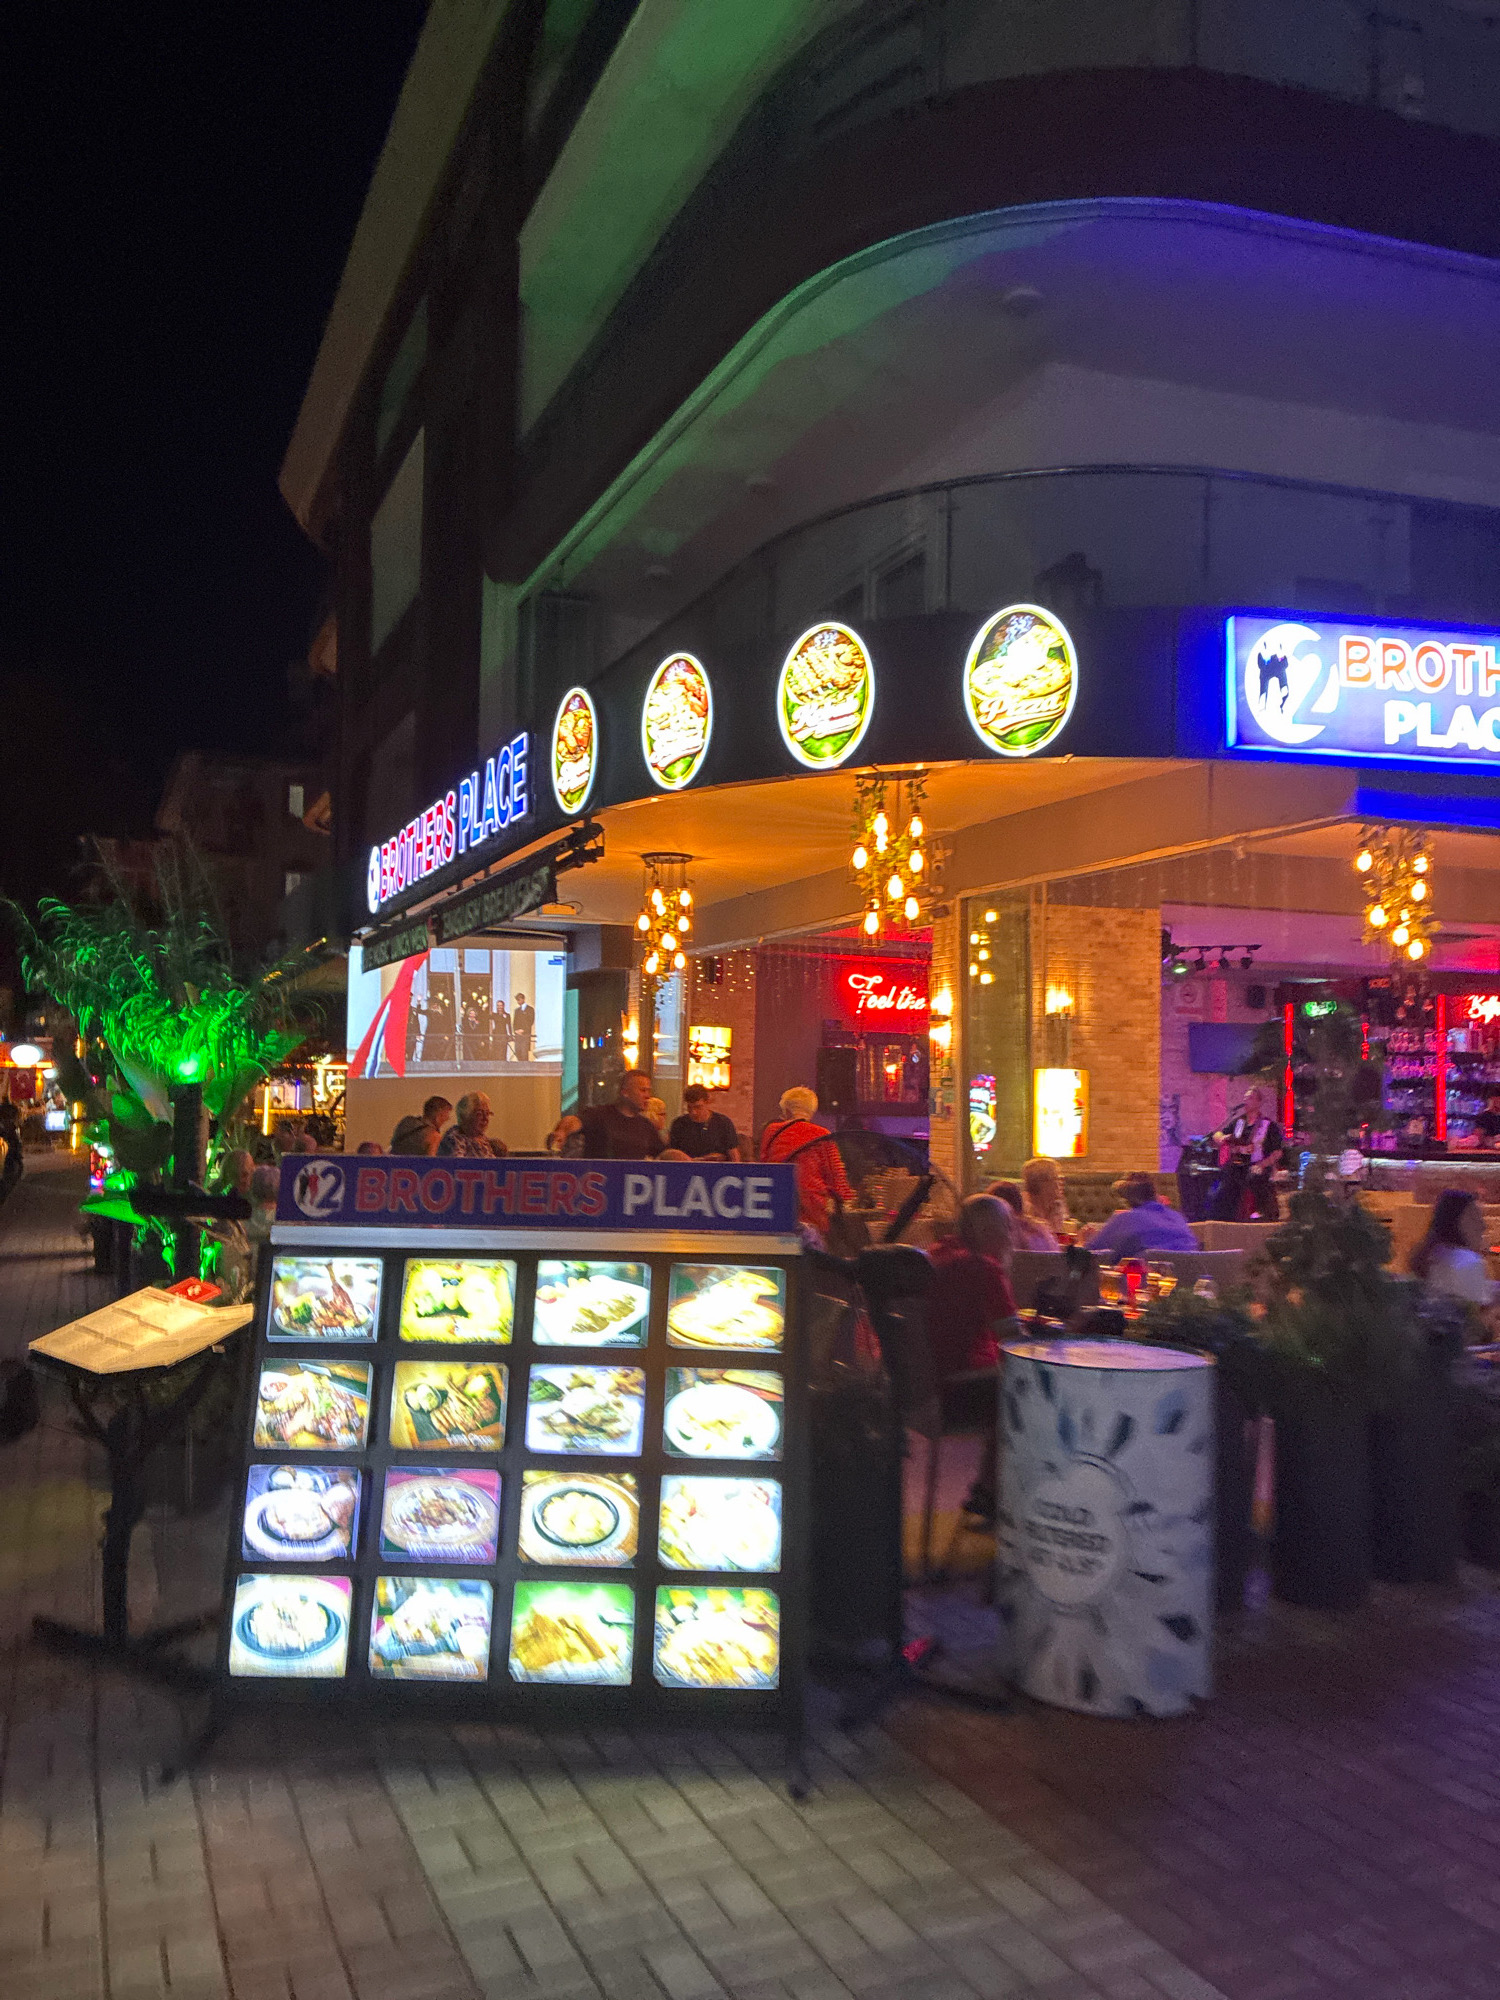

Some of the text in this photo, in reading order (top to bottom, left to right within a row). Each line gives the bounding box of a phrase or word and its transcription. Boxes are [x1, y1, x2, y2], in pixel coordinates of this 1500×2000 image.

[379, 790, 456, 903] BROTHERS
[458, 731, 528, 854] PLACE
[316, 1165, 775, 1219] 2 BROTHERS PLACE
